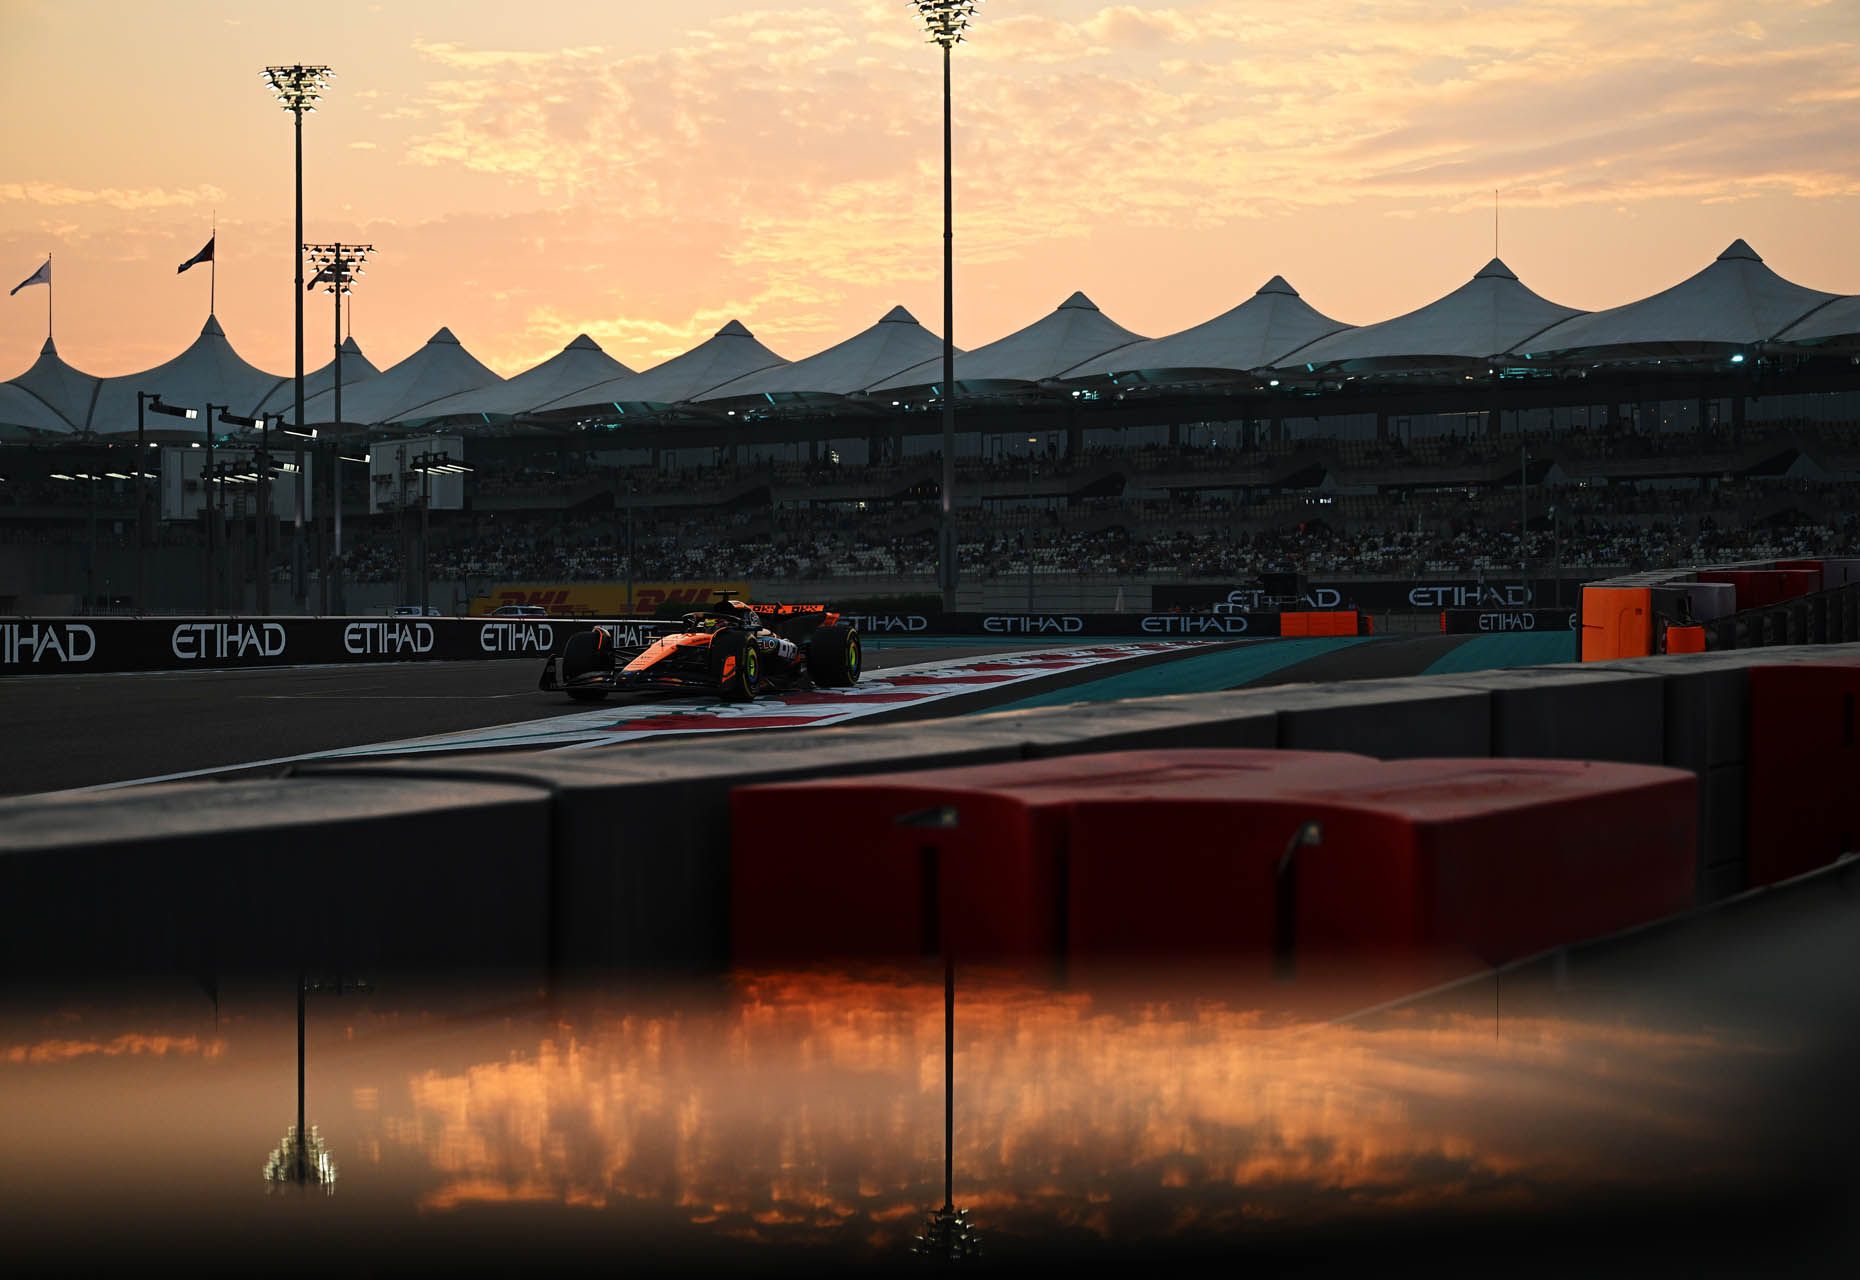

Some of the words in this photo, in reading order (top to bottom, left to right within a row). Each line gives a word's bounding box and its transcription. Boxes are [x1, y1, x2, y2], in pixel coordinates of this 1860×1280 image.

[498, 590, 571, 612] DHL
[1227, 588, 1341, 609] ETAD
[1408, 586, 1532, 606] ETIHAD
[983, 616, 1083, 633] ETIHAD
[1141, 616, 1248, 633] ETIHAD
[1478, 612, 1535, 631] ETIHAD
[0, 623, 96, 664] IHAD
[171, 623, 286, 659] ETIHAD
[344, 623, 434, 654] ETIHAD
[480, 622, 554, 652] ETIHAD
